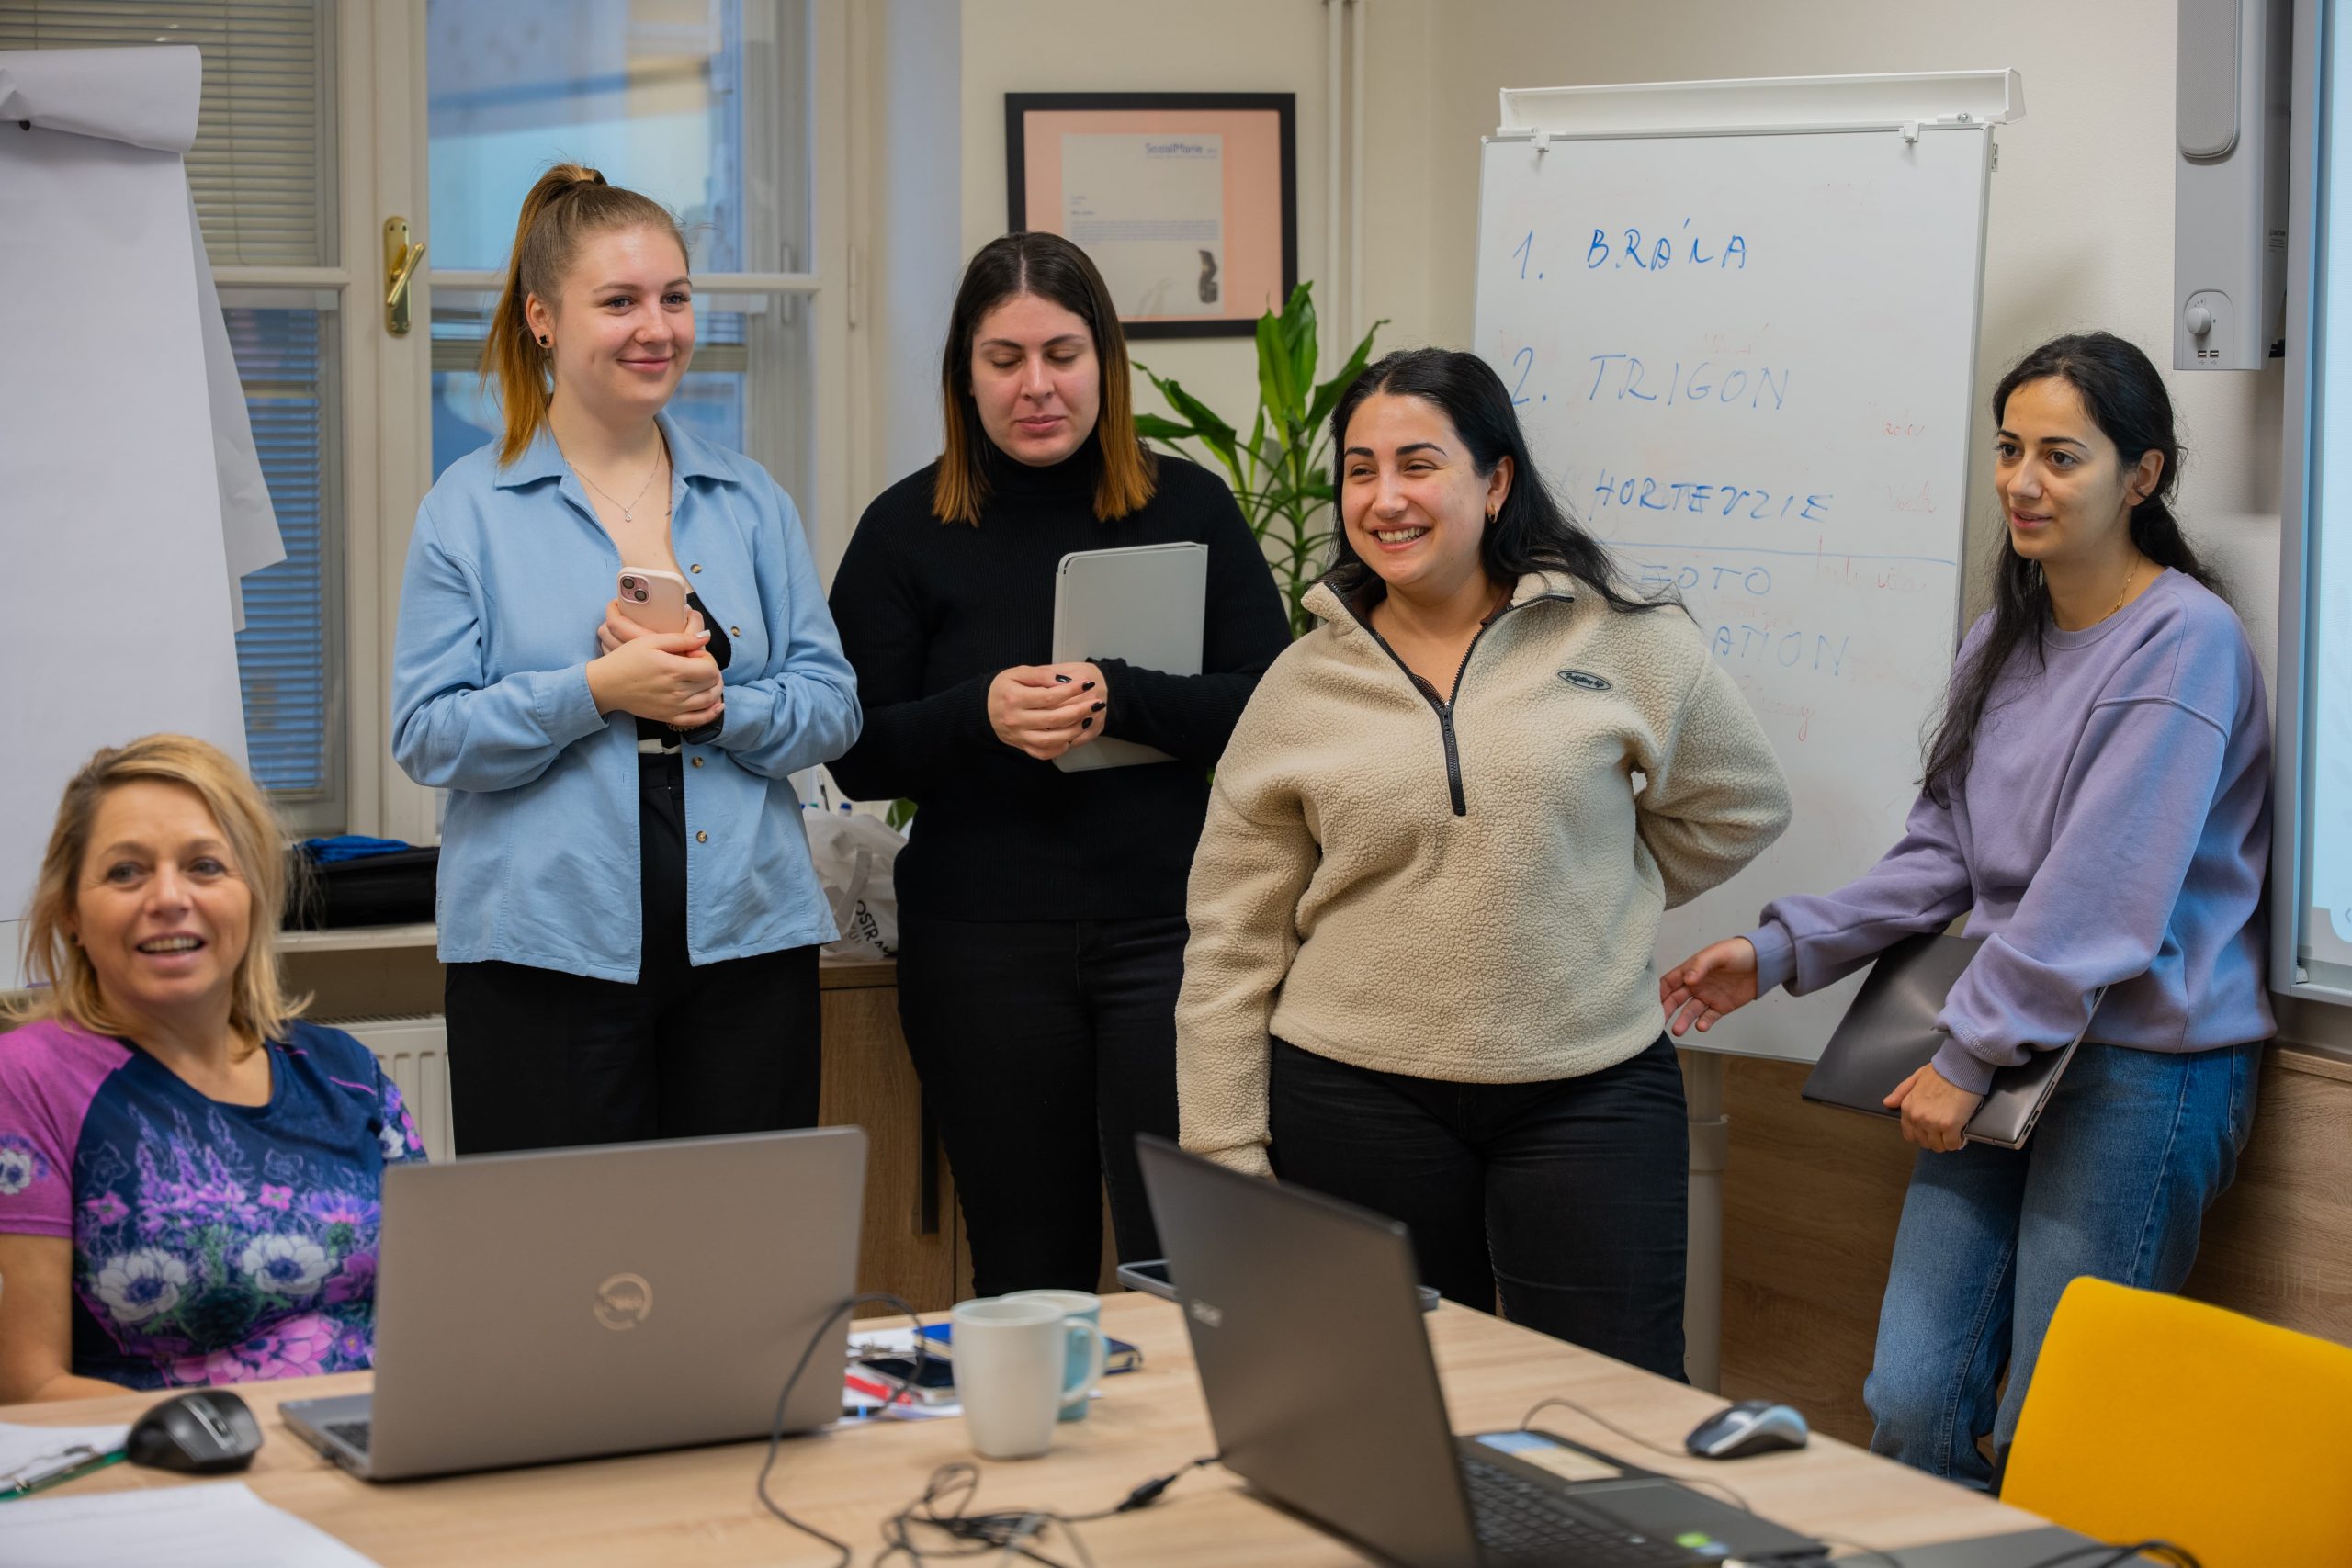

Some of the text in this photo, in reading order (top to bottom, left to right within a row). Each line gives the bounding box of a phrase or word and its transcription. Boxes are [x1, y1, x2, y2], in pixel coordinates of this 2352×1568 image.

[1513, 230, 1544, 279] 1.
[1511, 346, 1790, 410] 2. TRIGON
[1712, 625, 1850, 676] ATION
